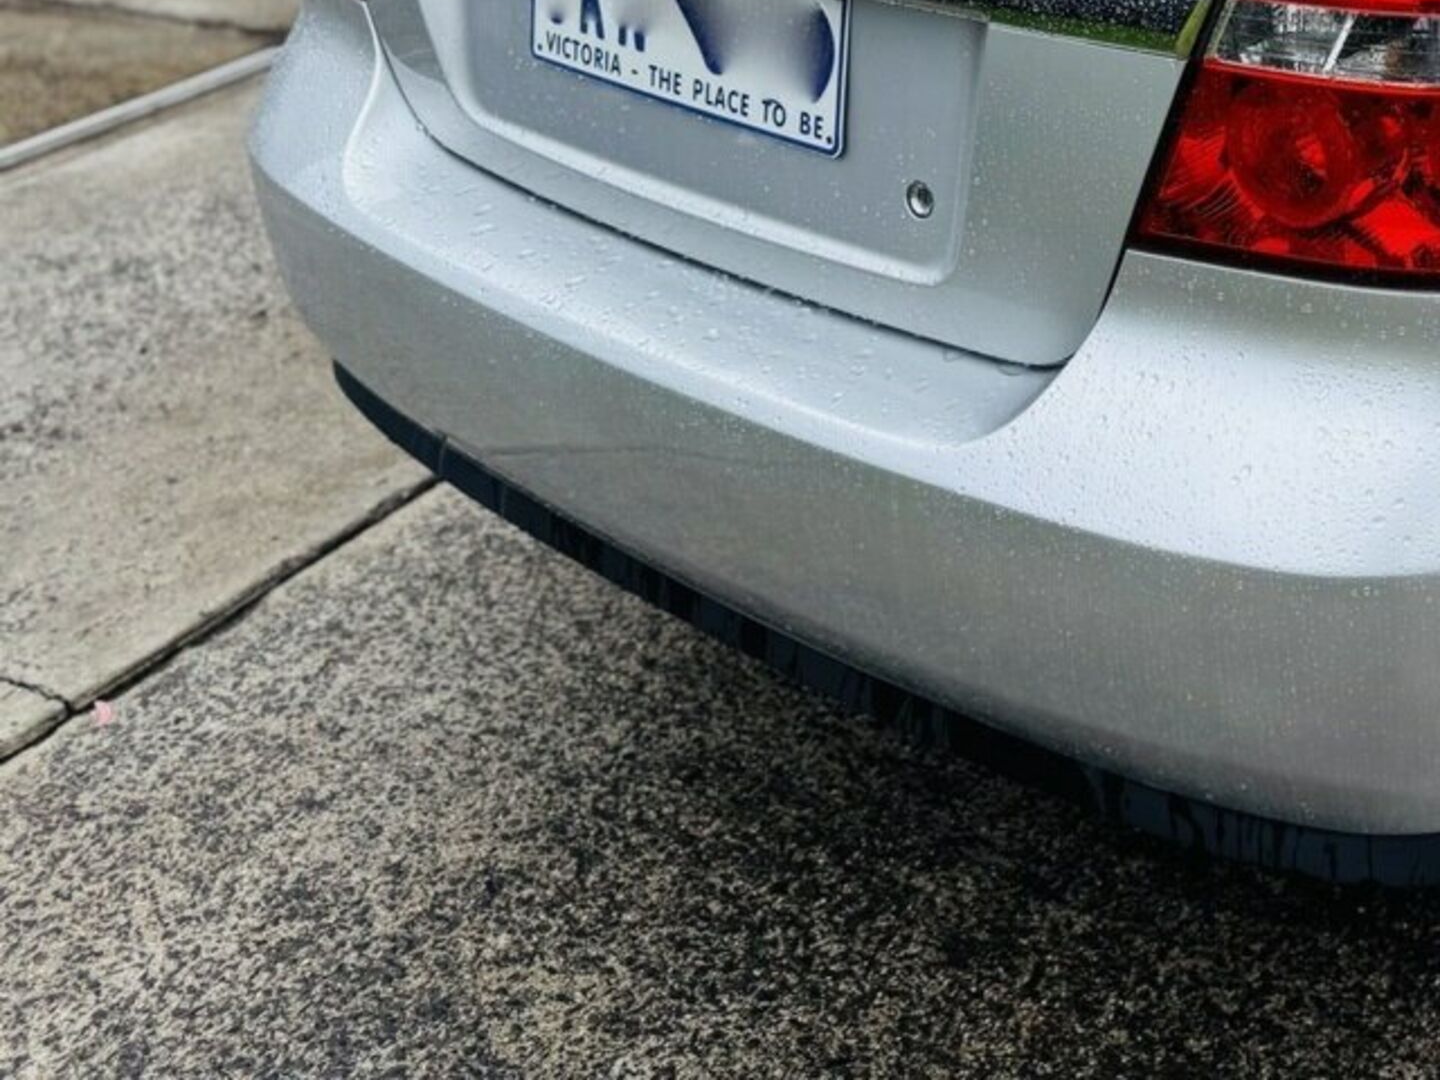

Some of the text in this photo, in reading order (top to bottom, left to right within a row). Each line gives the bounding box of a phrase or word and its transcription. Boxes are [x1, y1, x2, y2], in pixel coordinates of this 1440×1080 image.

[546, 31, 622, 76] VICTORIA
[649, 64, 682, 96] THE
[693, 79, 750, 117] PLACE
[762, 98, 786, 127] TO
